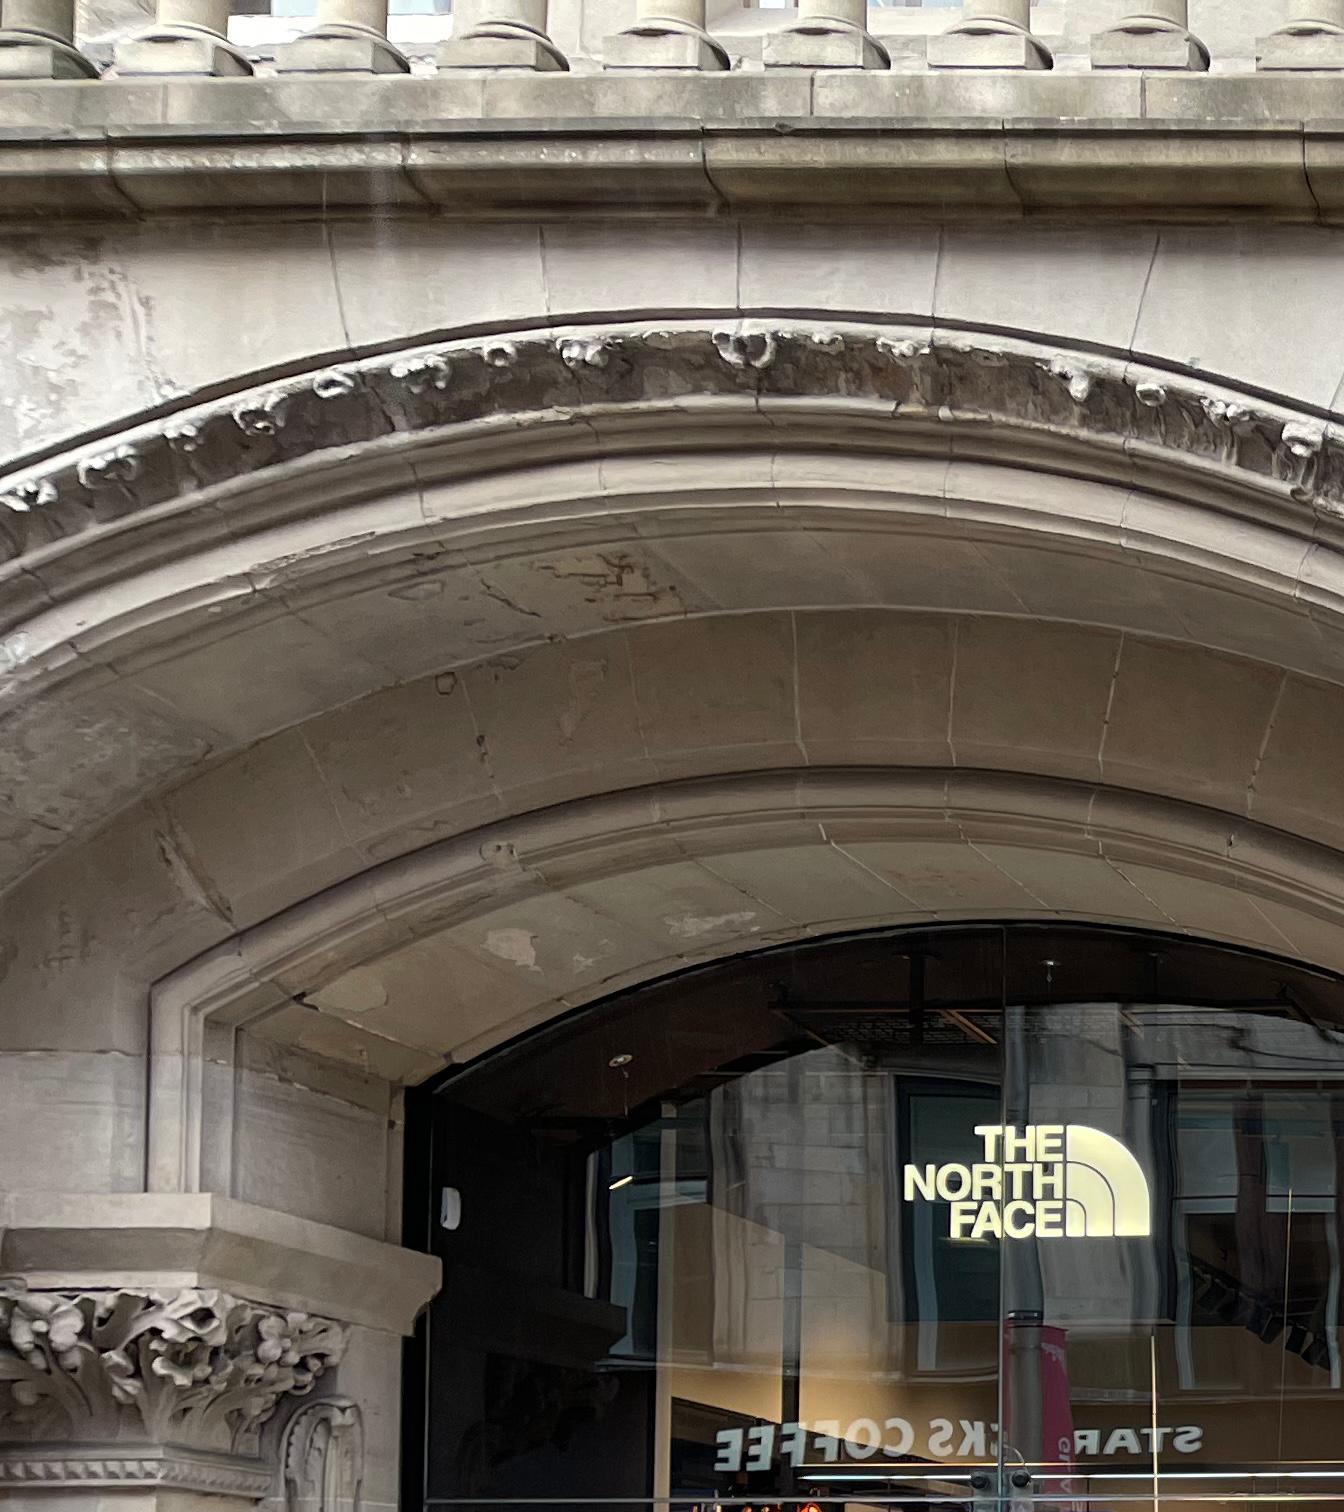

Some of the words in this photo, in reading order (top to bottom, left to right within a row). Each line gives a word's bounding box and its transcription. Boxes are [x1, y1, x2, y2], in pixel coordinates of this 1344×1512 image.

[974, 1125, 1064, 1162] THE
[903, 1163, 1064, 1201] NORTH
[950, 1200, 1064, 1239] FACE
